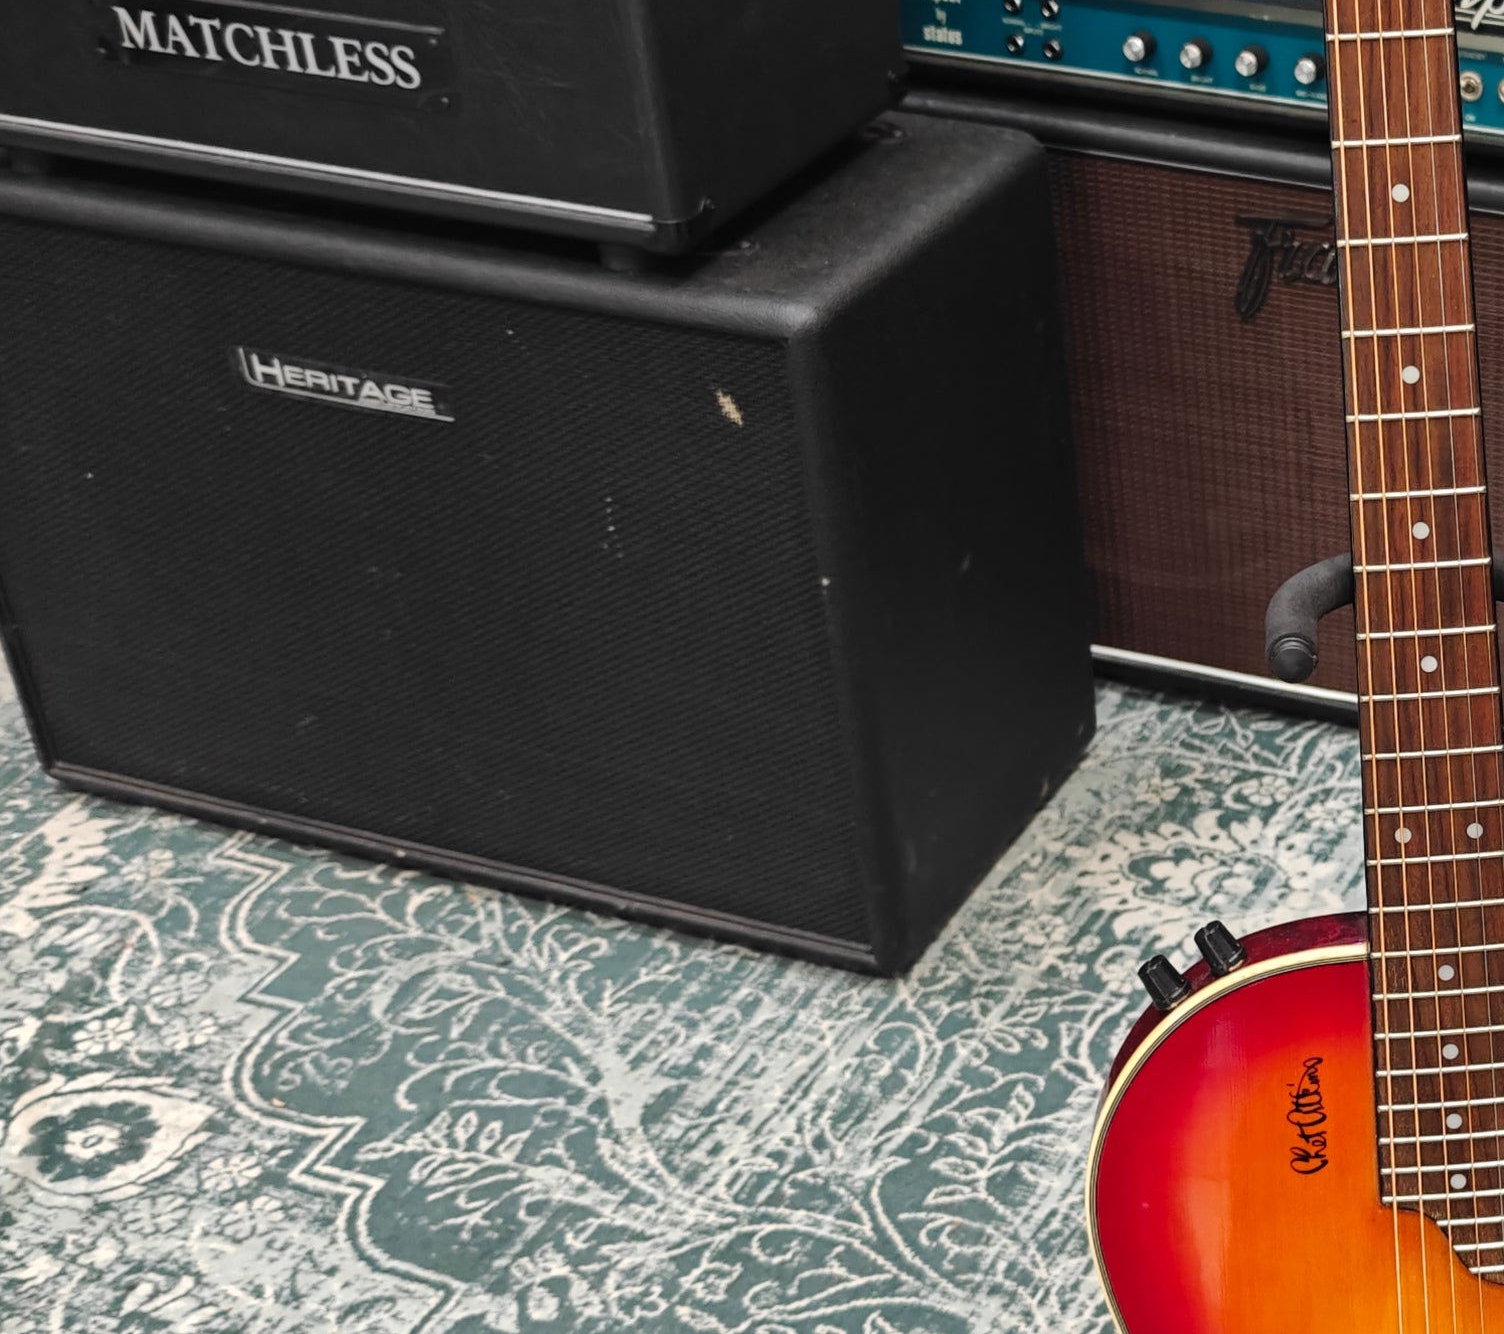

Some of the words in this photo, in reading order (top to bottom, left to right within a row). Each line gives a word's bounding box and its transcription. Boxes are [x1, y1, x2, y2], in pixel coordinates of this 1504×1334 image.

[111, 5, 422, 90] MATCHLESS
[923, 25, 963, 46] status
[250, 352, 436, 410] HERITAGE
